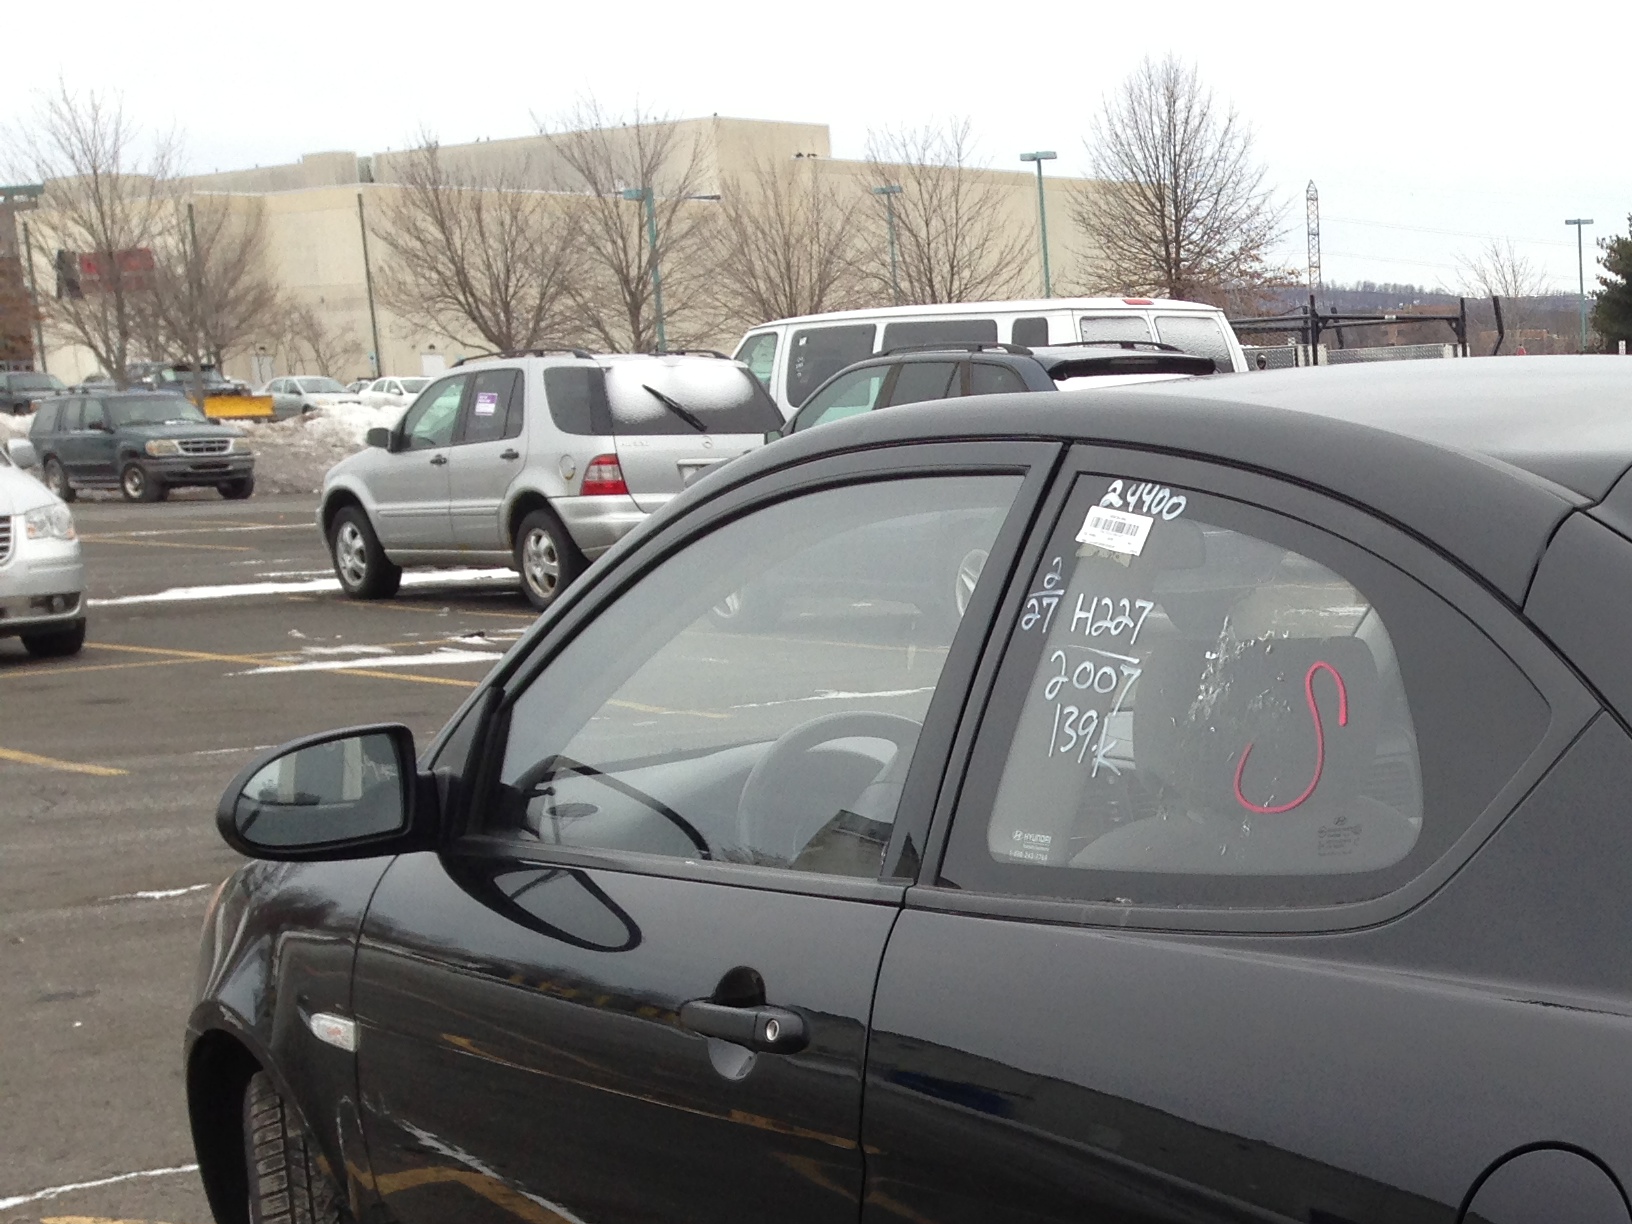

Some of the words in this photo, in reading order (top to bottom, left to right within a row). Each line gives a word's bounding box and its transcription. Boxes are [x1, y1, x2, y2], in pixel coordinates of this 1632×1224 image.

[1099, 479, 1187, 520] 24400
[1070, 592, 1154, 645] H227
[1044, 650, 1142, 716] 2007
